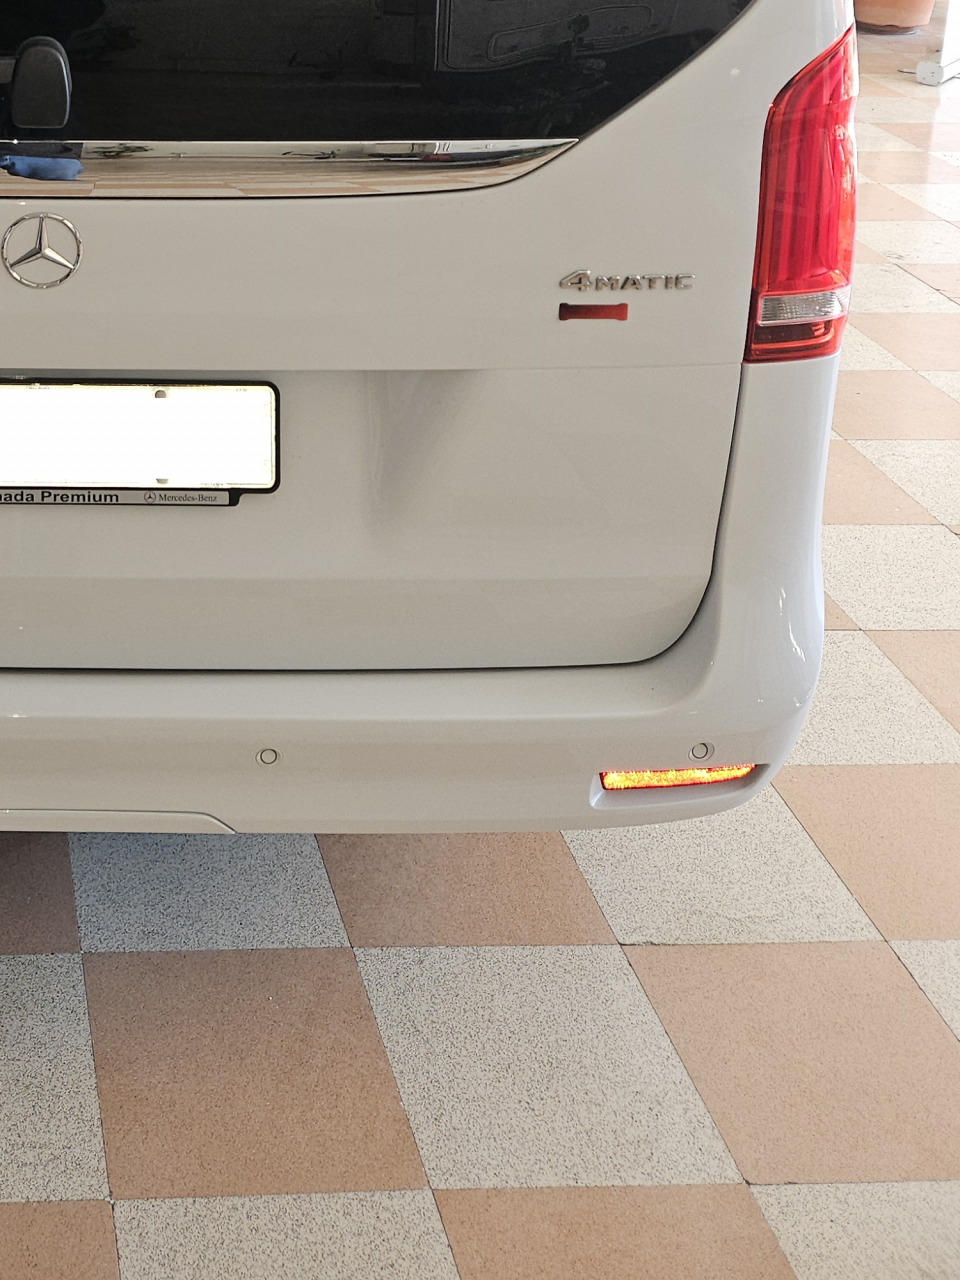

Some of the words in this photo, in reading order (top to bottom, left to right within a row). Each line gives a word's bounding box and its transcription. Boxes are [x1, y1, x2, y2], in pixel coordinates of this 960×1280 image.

[559, 269, 696, 292] 4MATIC
[41, 490, 119, 503] Premium
[158, 493, 217, 502] Mercedes-Benz
